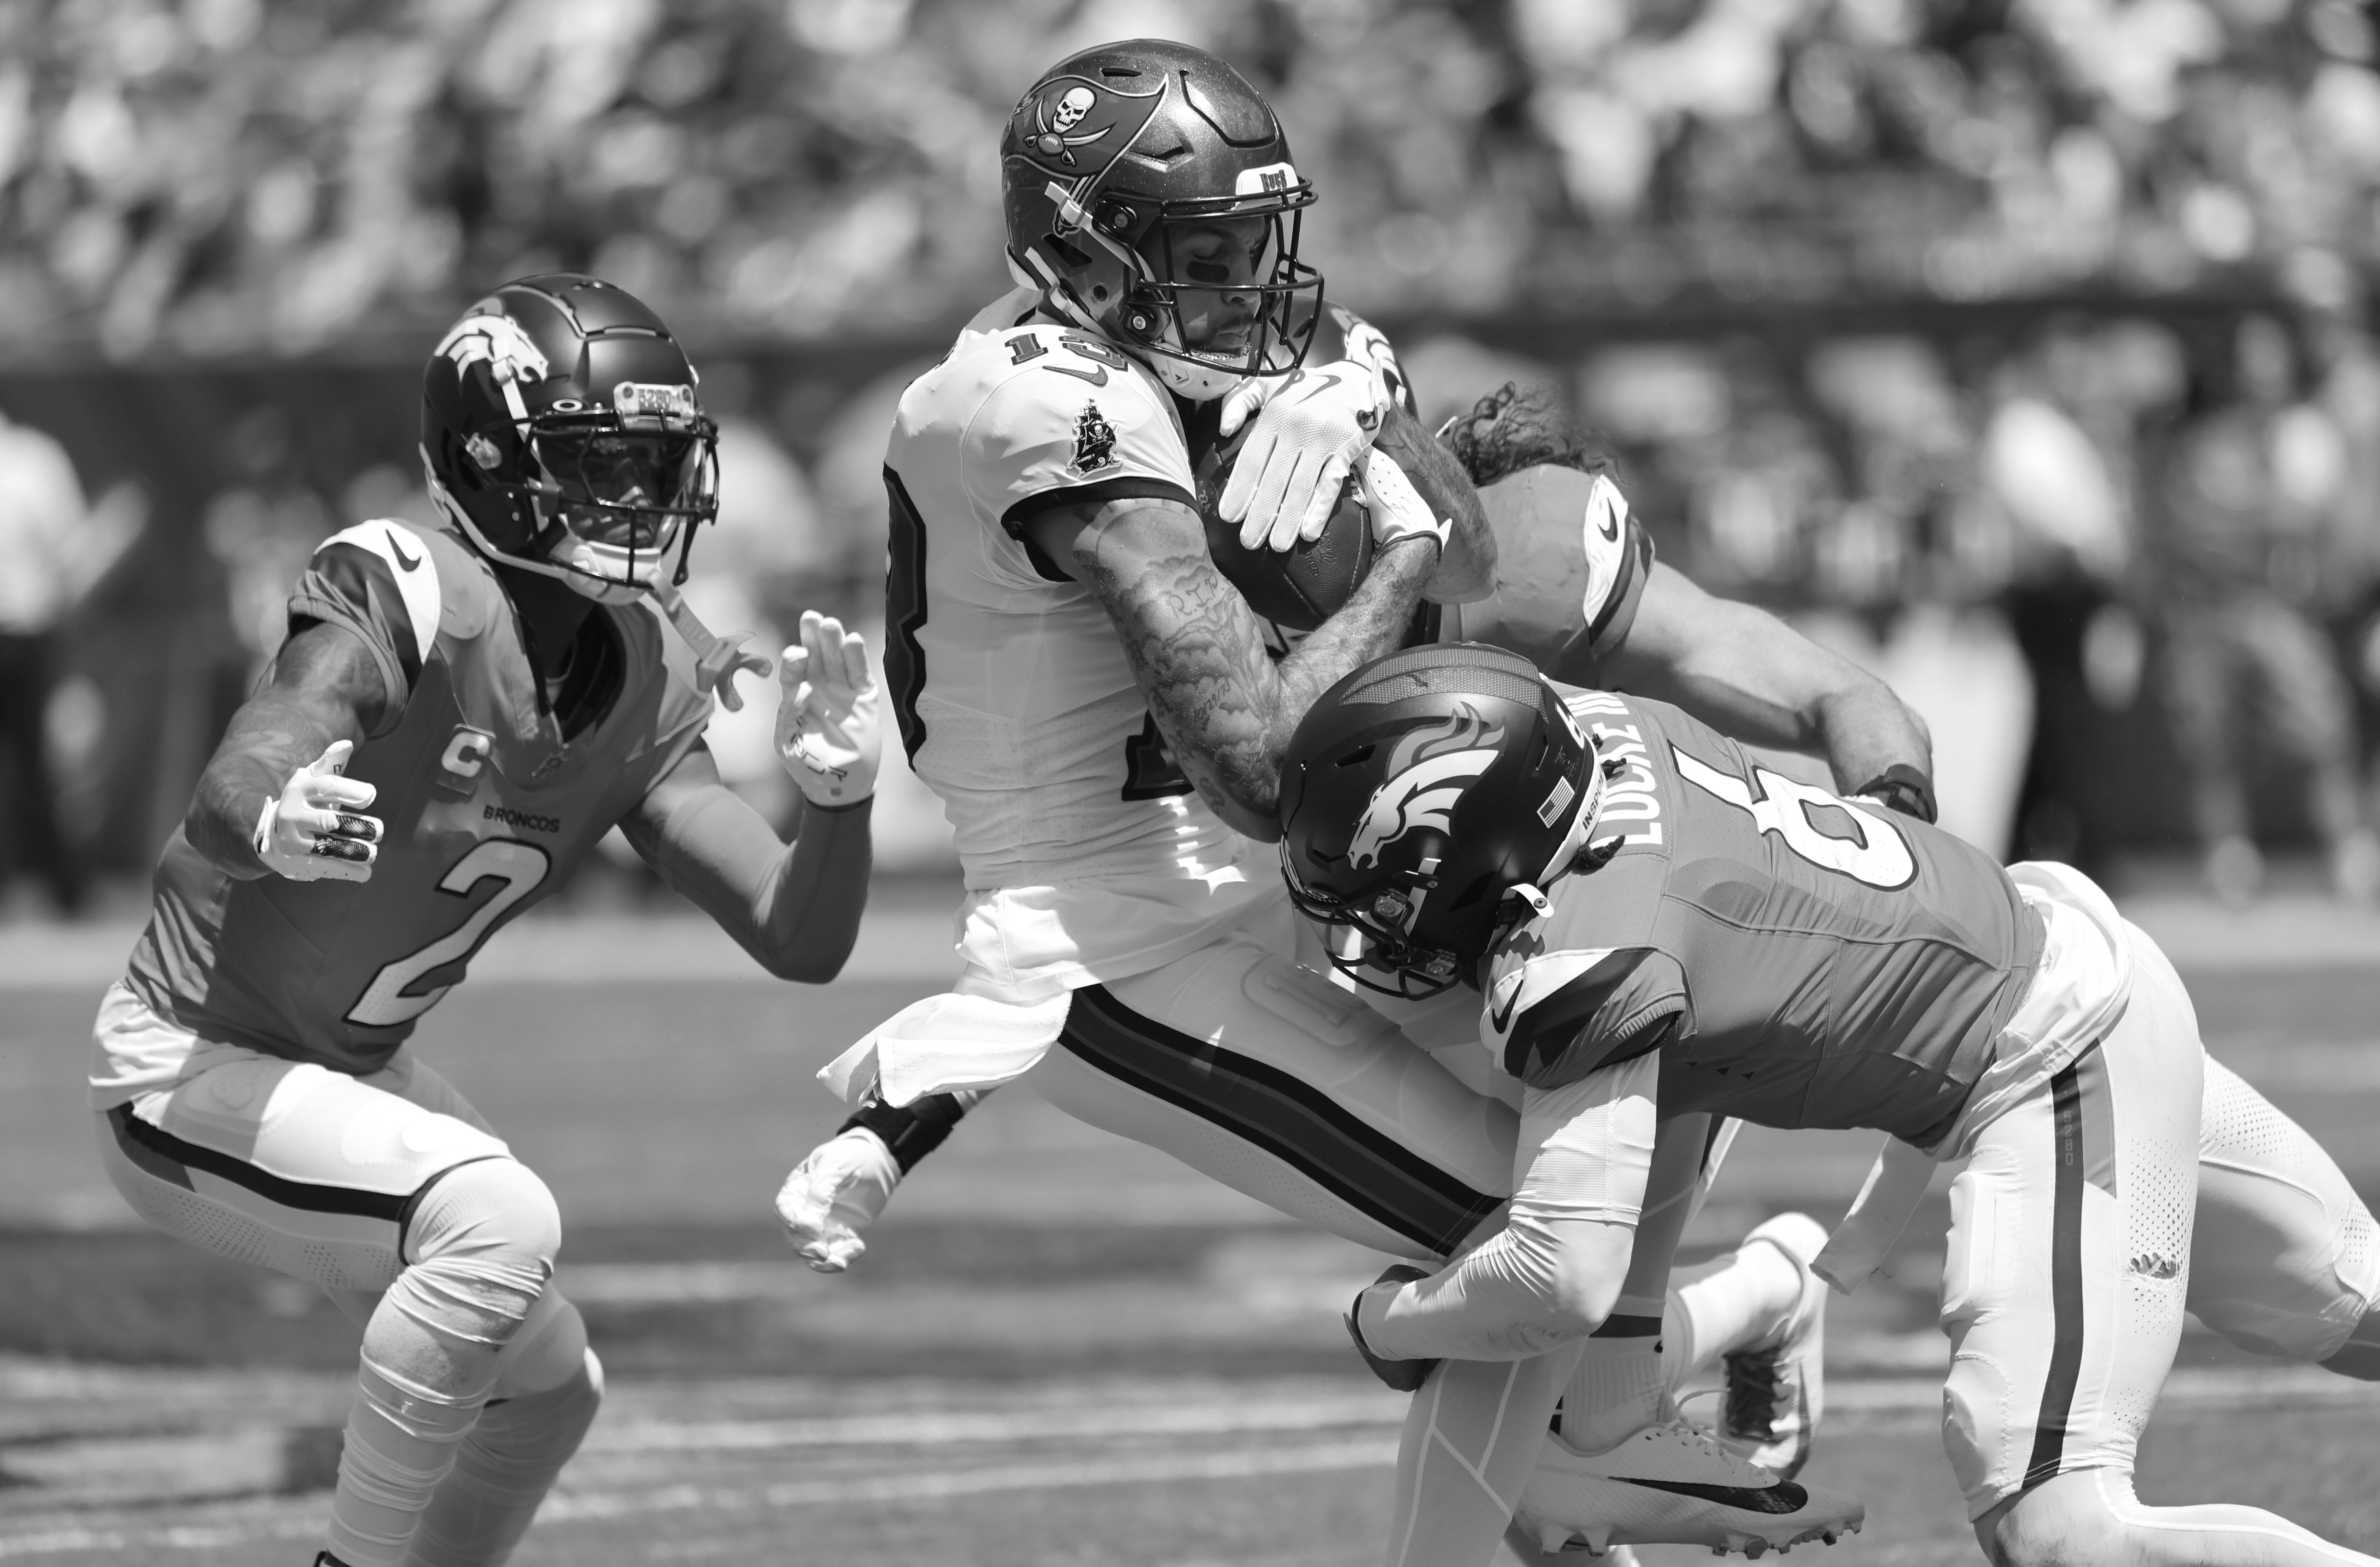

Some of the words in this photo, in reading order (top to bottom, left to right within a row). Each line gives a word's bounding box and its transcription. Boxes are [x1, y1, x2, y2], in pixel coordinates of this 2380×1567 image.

[1259, 169, 1287, 193] BUCS
[441, 732, 490, 778] C
[483, 805, 561, 833] BRONCOS
[1582, 775, 1605, 830] INSPIRE
[1666, 738, 1920, 892] 6
[341, 836, 552, 1029] 2
[2064, 1110, 2074, 1166] 5280
